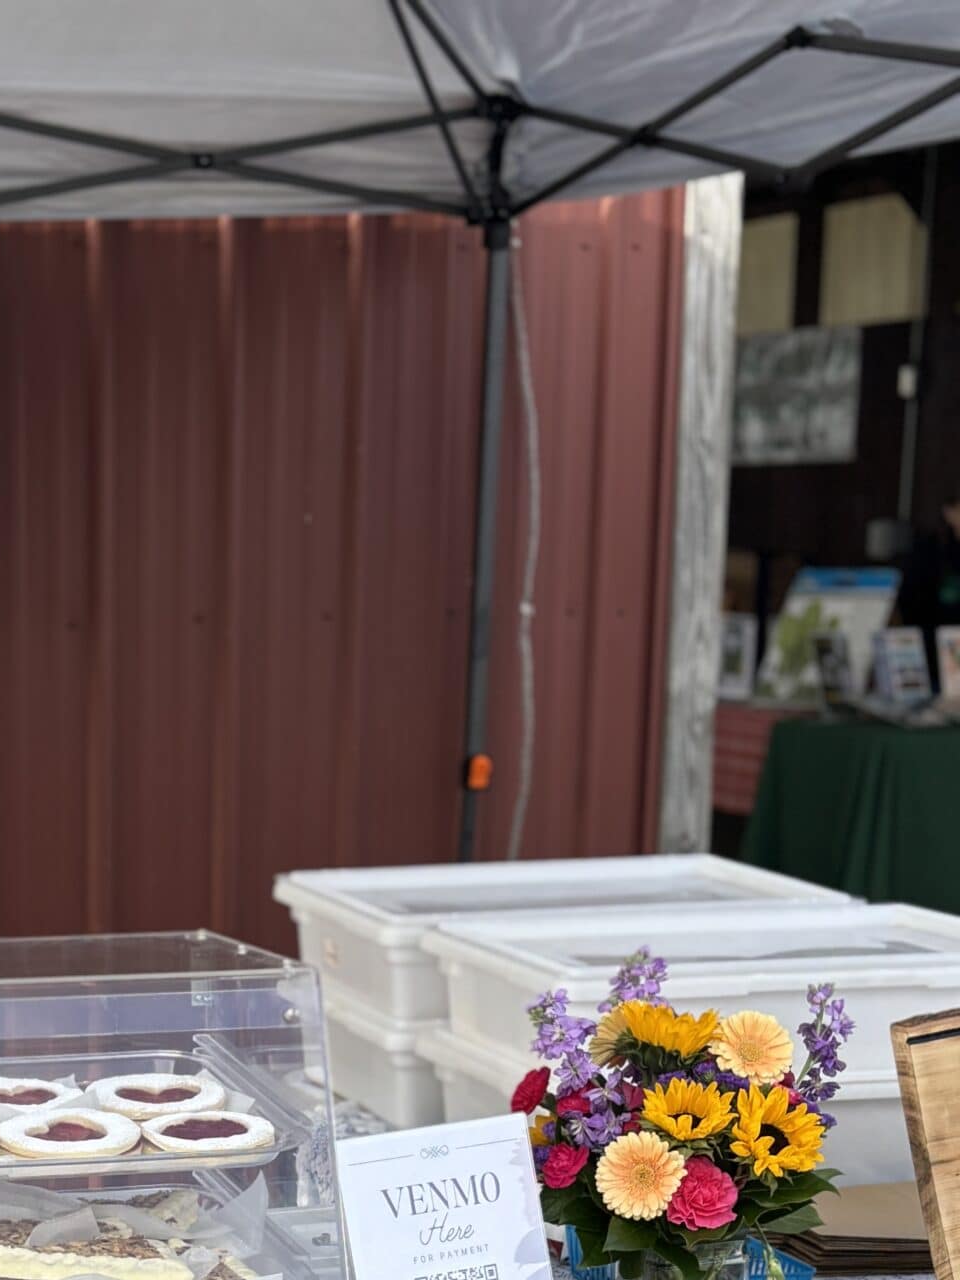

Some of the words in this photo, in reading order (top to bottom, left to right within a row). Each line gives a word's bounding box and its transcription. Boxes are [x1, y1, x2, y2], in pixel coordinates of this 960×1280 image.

[380, 1171, 500, 1219] VENMO
[419, 1211, 474, 1246] Here
[413, 1254, 434, 1264] FOR
[439, 1243, 489, 1261] PAYMENT
